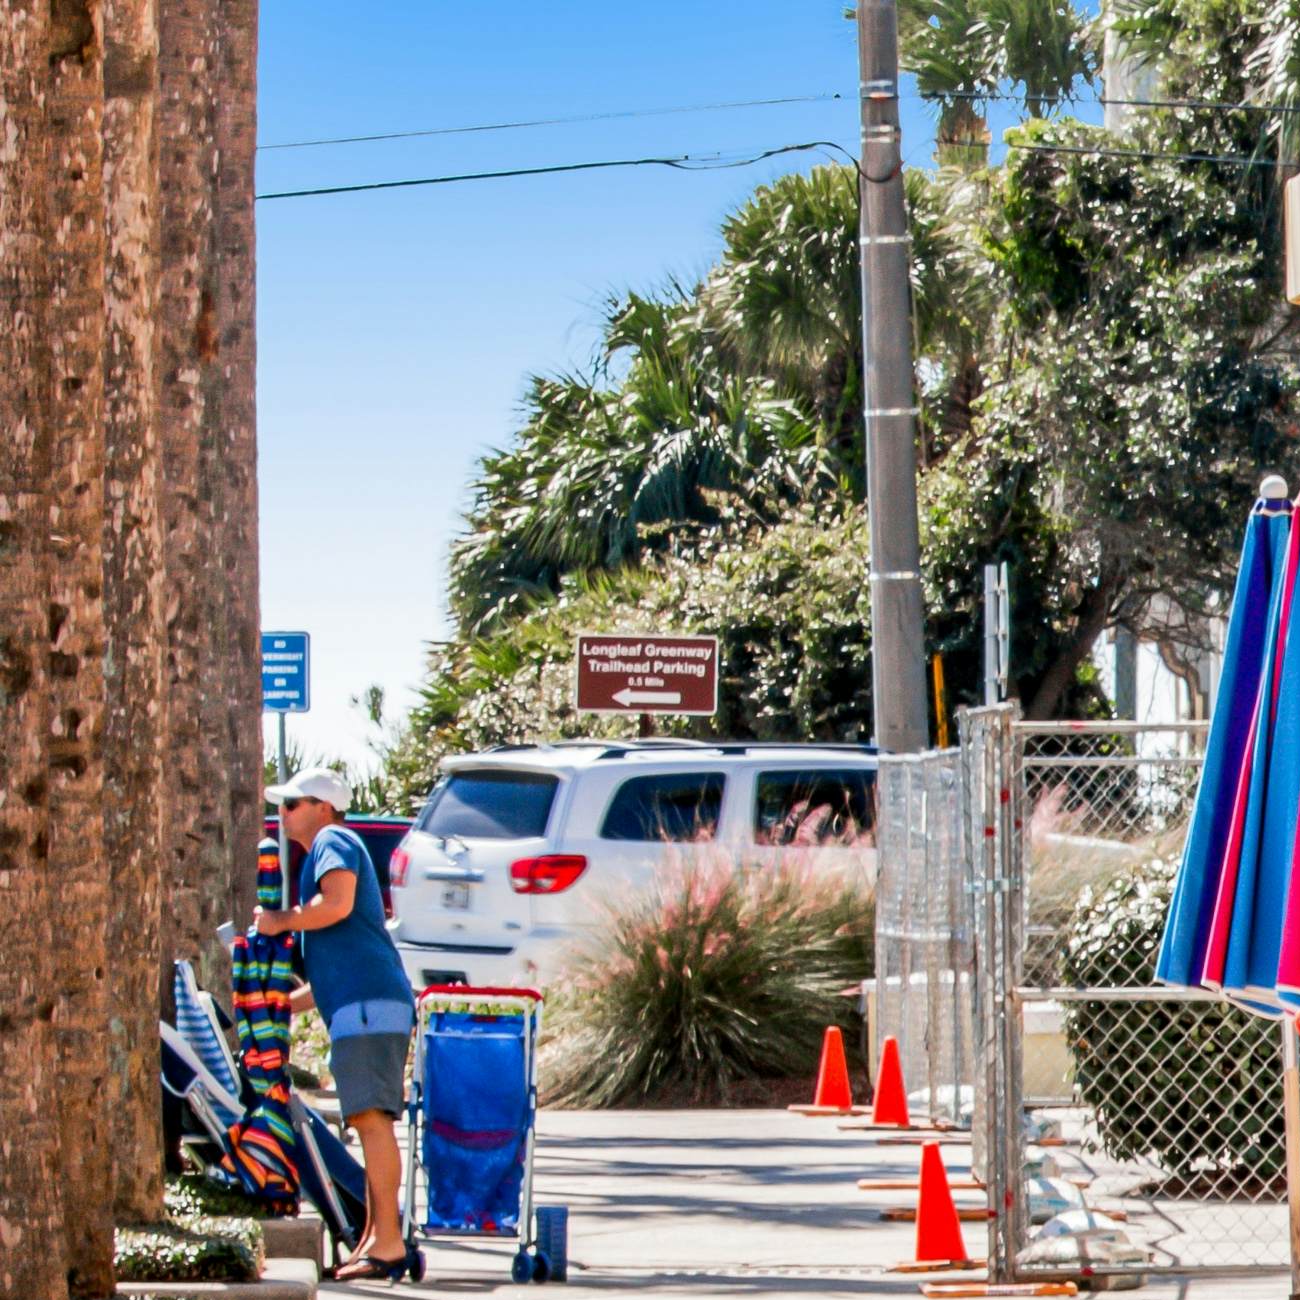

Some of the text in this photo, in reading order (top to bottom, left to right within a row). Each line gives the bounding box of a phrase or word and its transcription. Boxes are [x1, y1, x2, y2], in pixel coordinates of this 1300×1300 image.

[582, 643, 712, 660] Longleaf Greenway
[588, 659, 705, 677] Trailhead Parking
